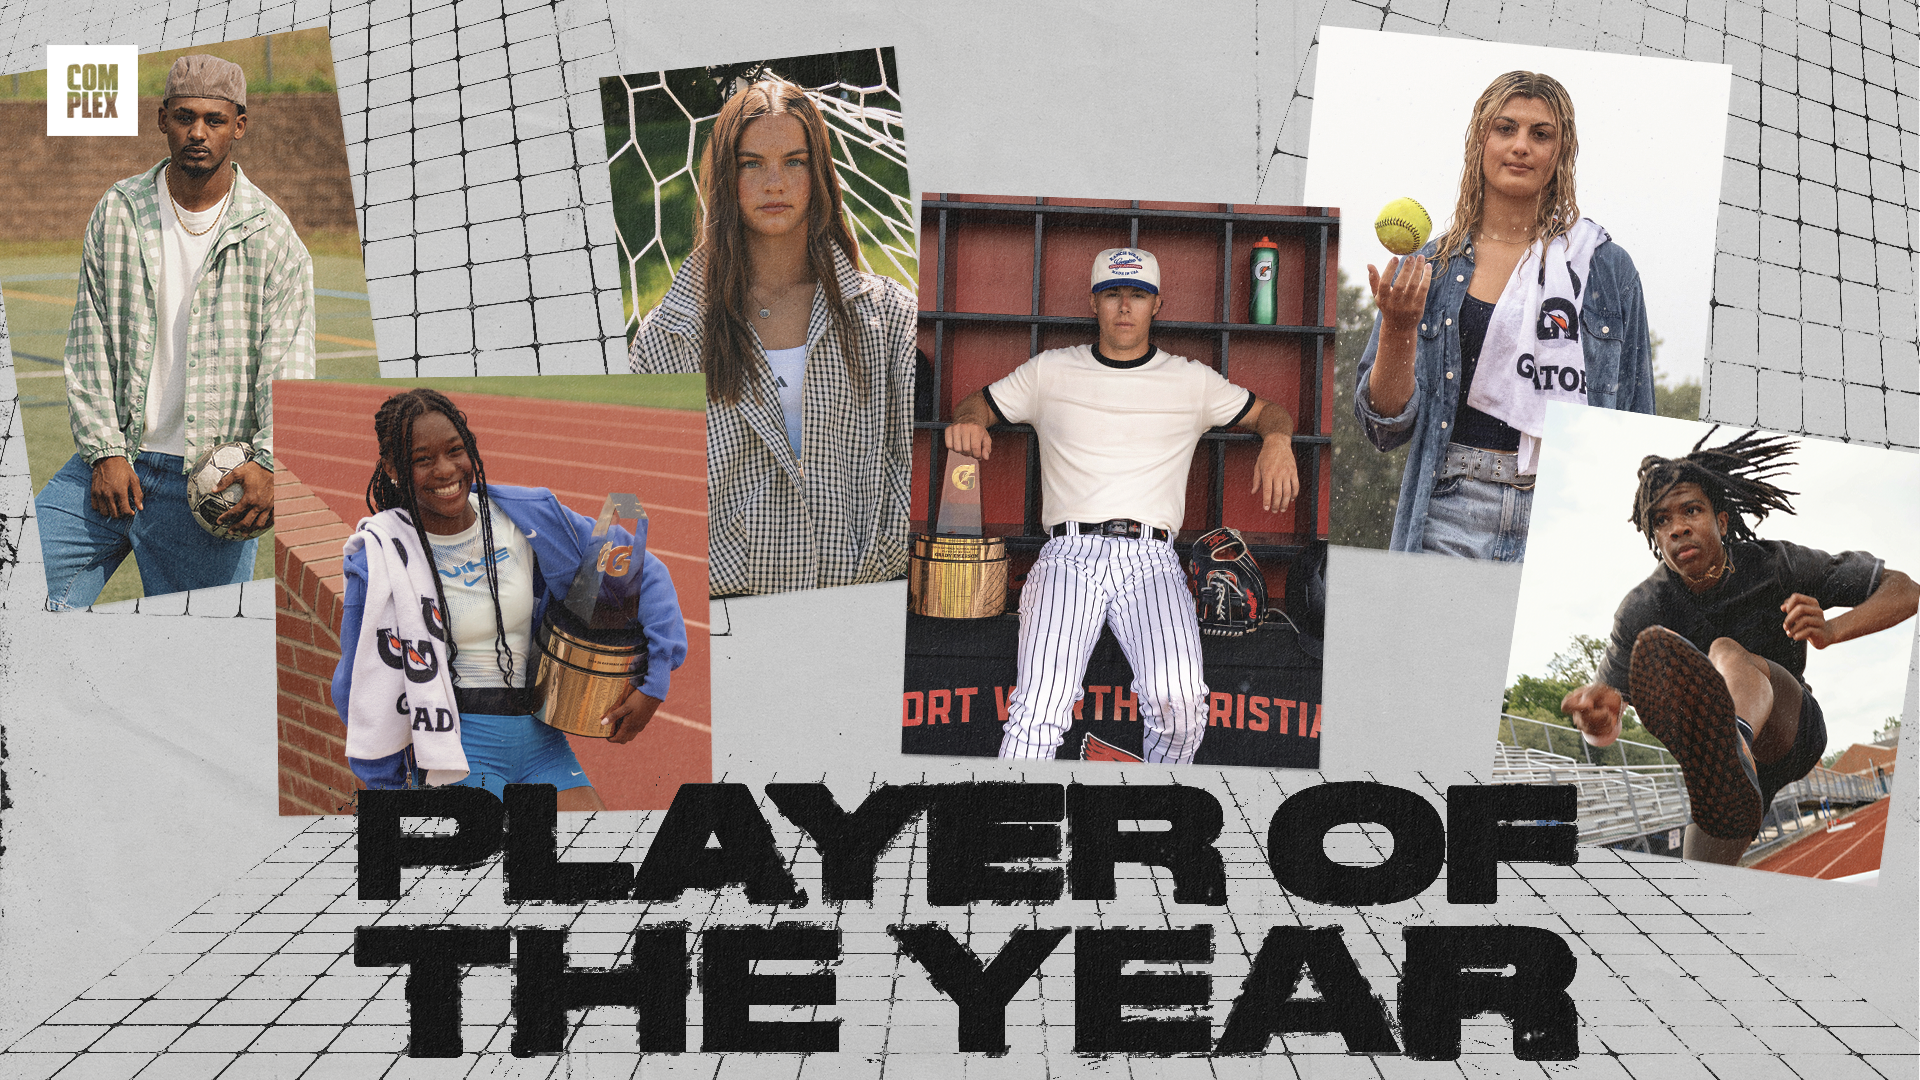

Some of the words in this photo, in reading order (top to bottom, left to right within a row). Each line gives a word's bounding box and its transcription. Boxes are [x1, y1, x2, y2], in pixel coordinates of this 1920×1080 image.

[952, 464, 975, 490] G
[438, 547, 510, 578] NIKE
[994, 685, 1139, 722] WTH
[1204, 691, 1322, 739] RISTI
